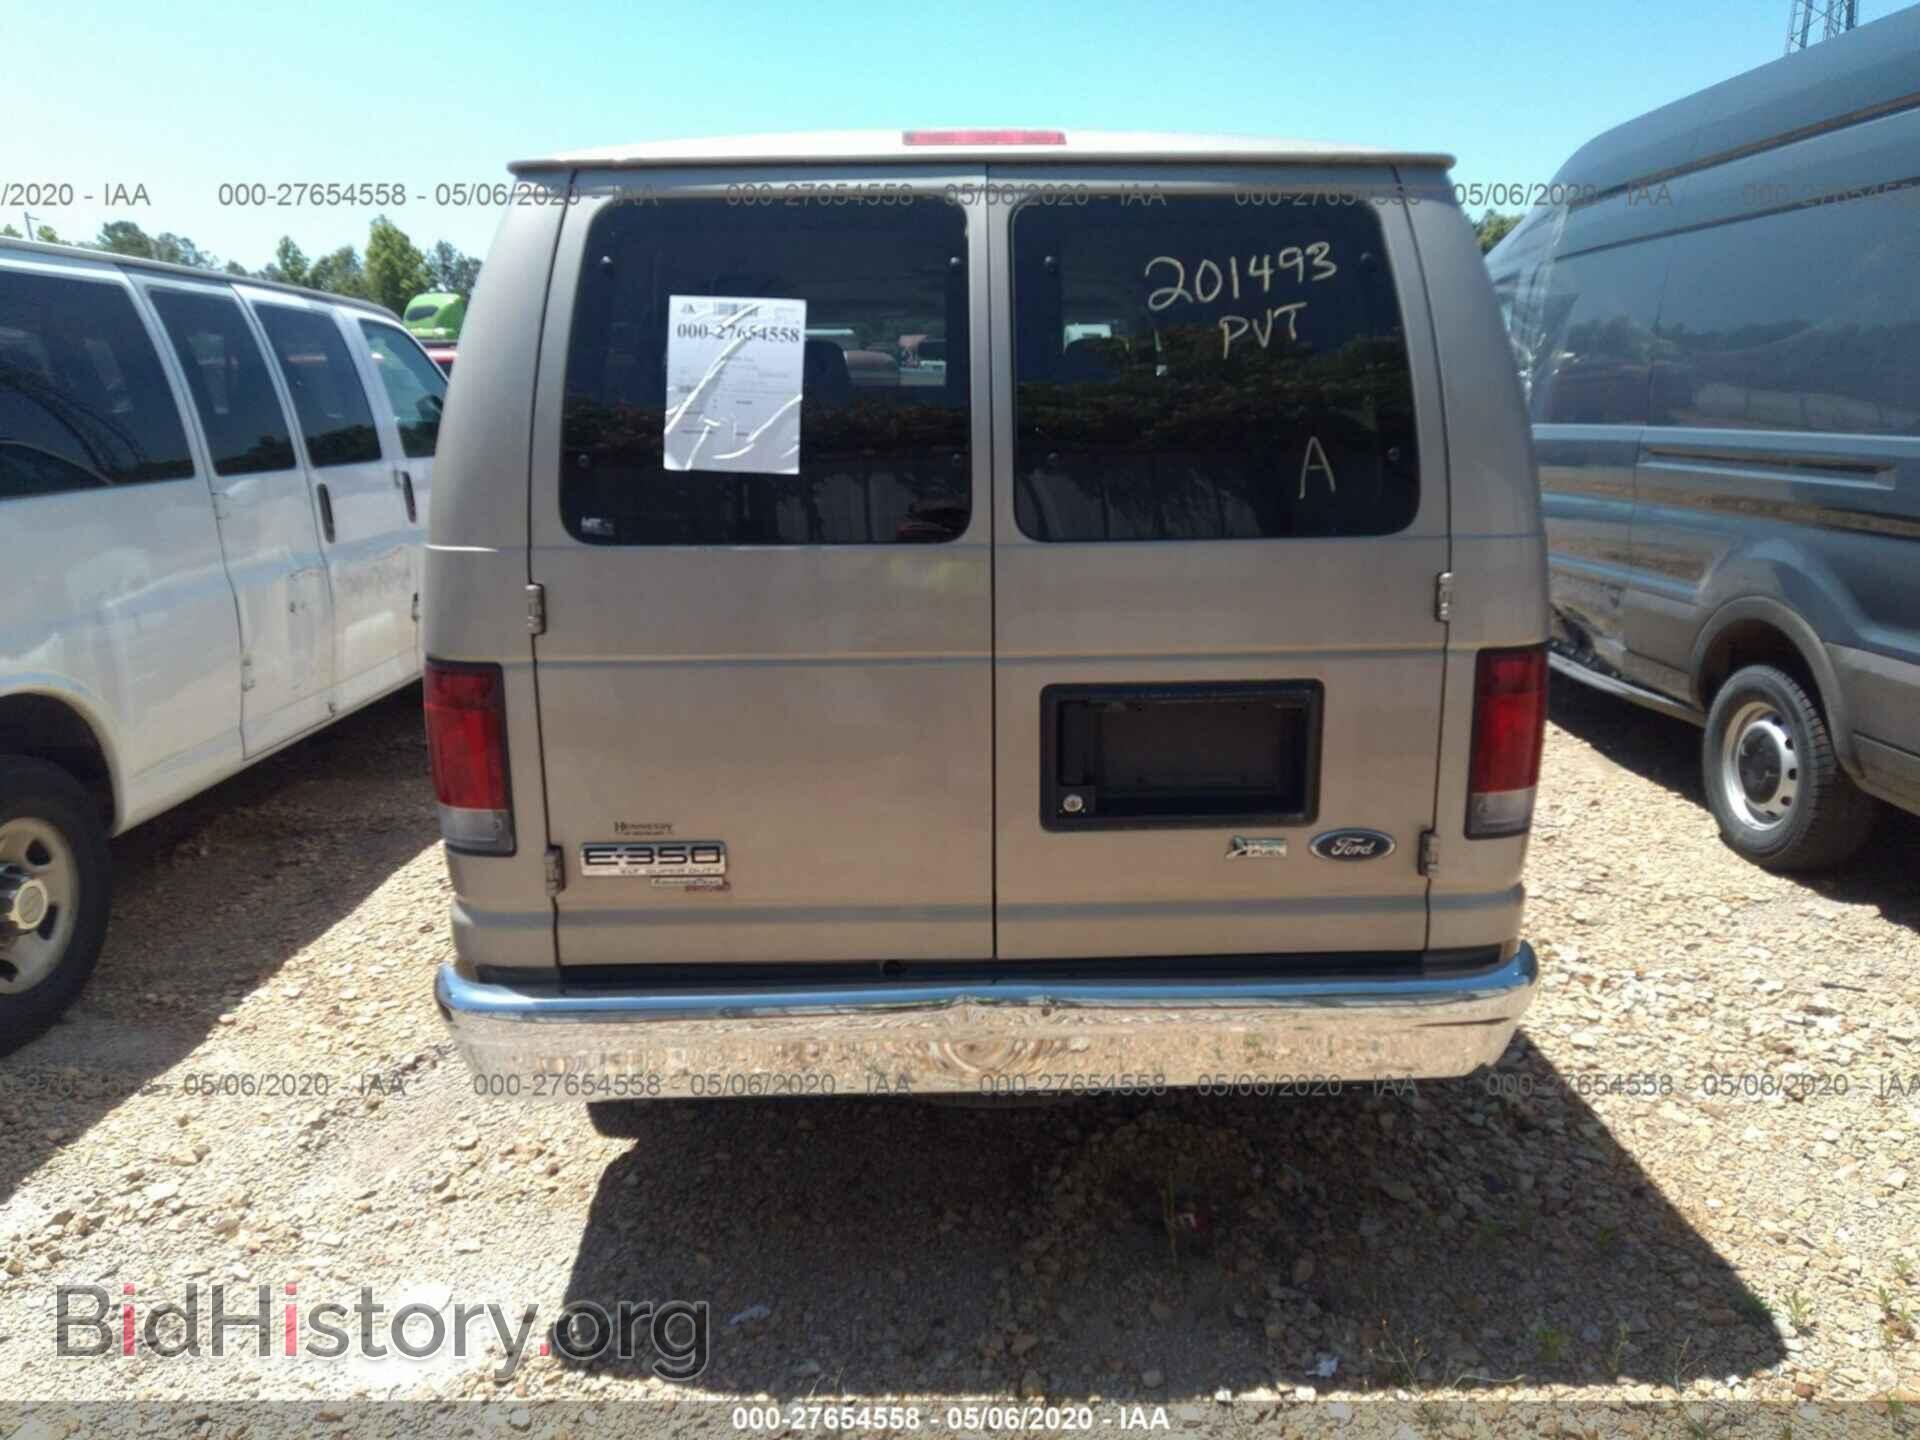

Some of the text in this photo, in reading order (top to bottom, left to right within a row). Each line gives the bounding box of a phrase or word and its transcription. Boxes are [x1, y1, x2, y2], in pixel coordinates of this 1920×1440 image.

[1145, 242, 1338, 311] 201493
[676, 322, 801, 343] 000-27654558
[1219, 302, 1308, 360] PVT
[1299, 436, 1336, 500] A
[584, 847, 721, 865] E-350
[1331, 837, 1377, 856] Ford
